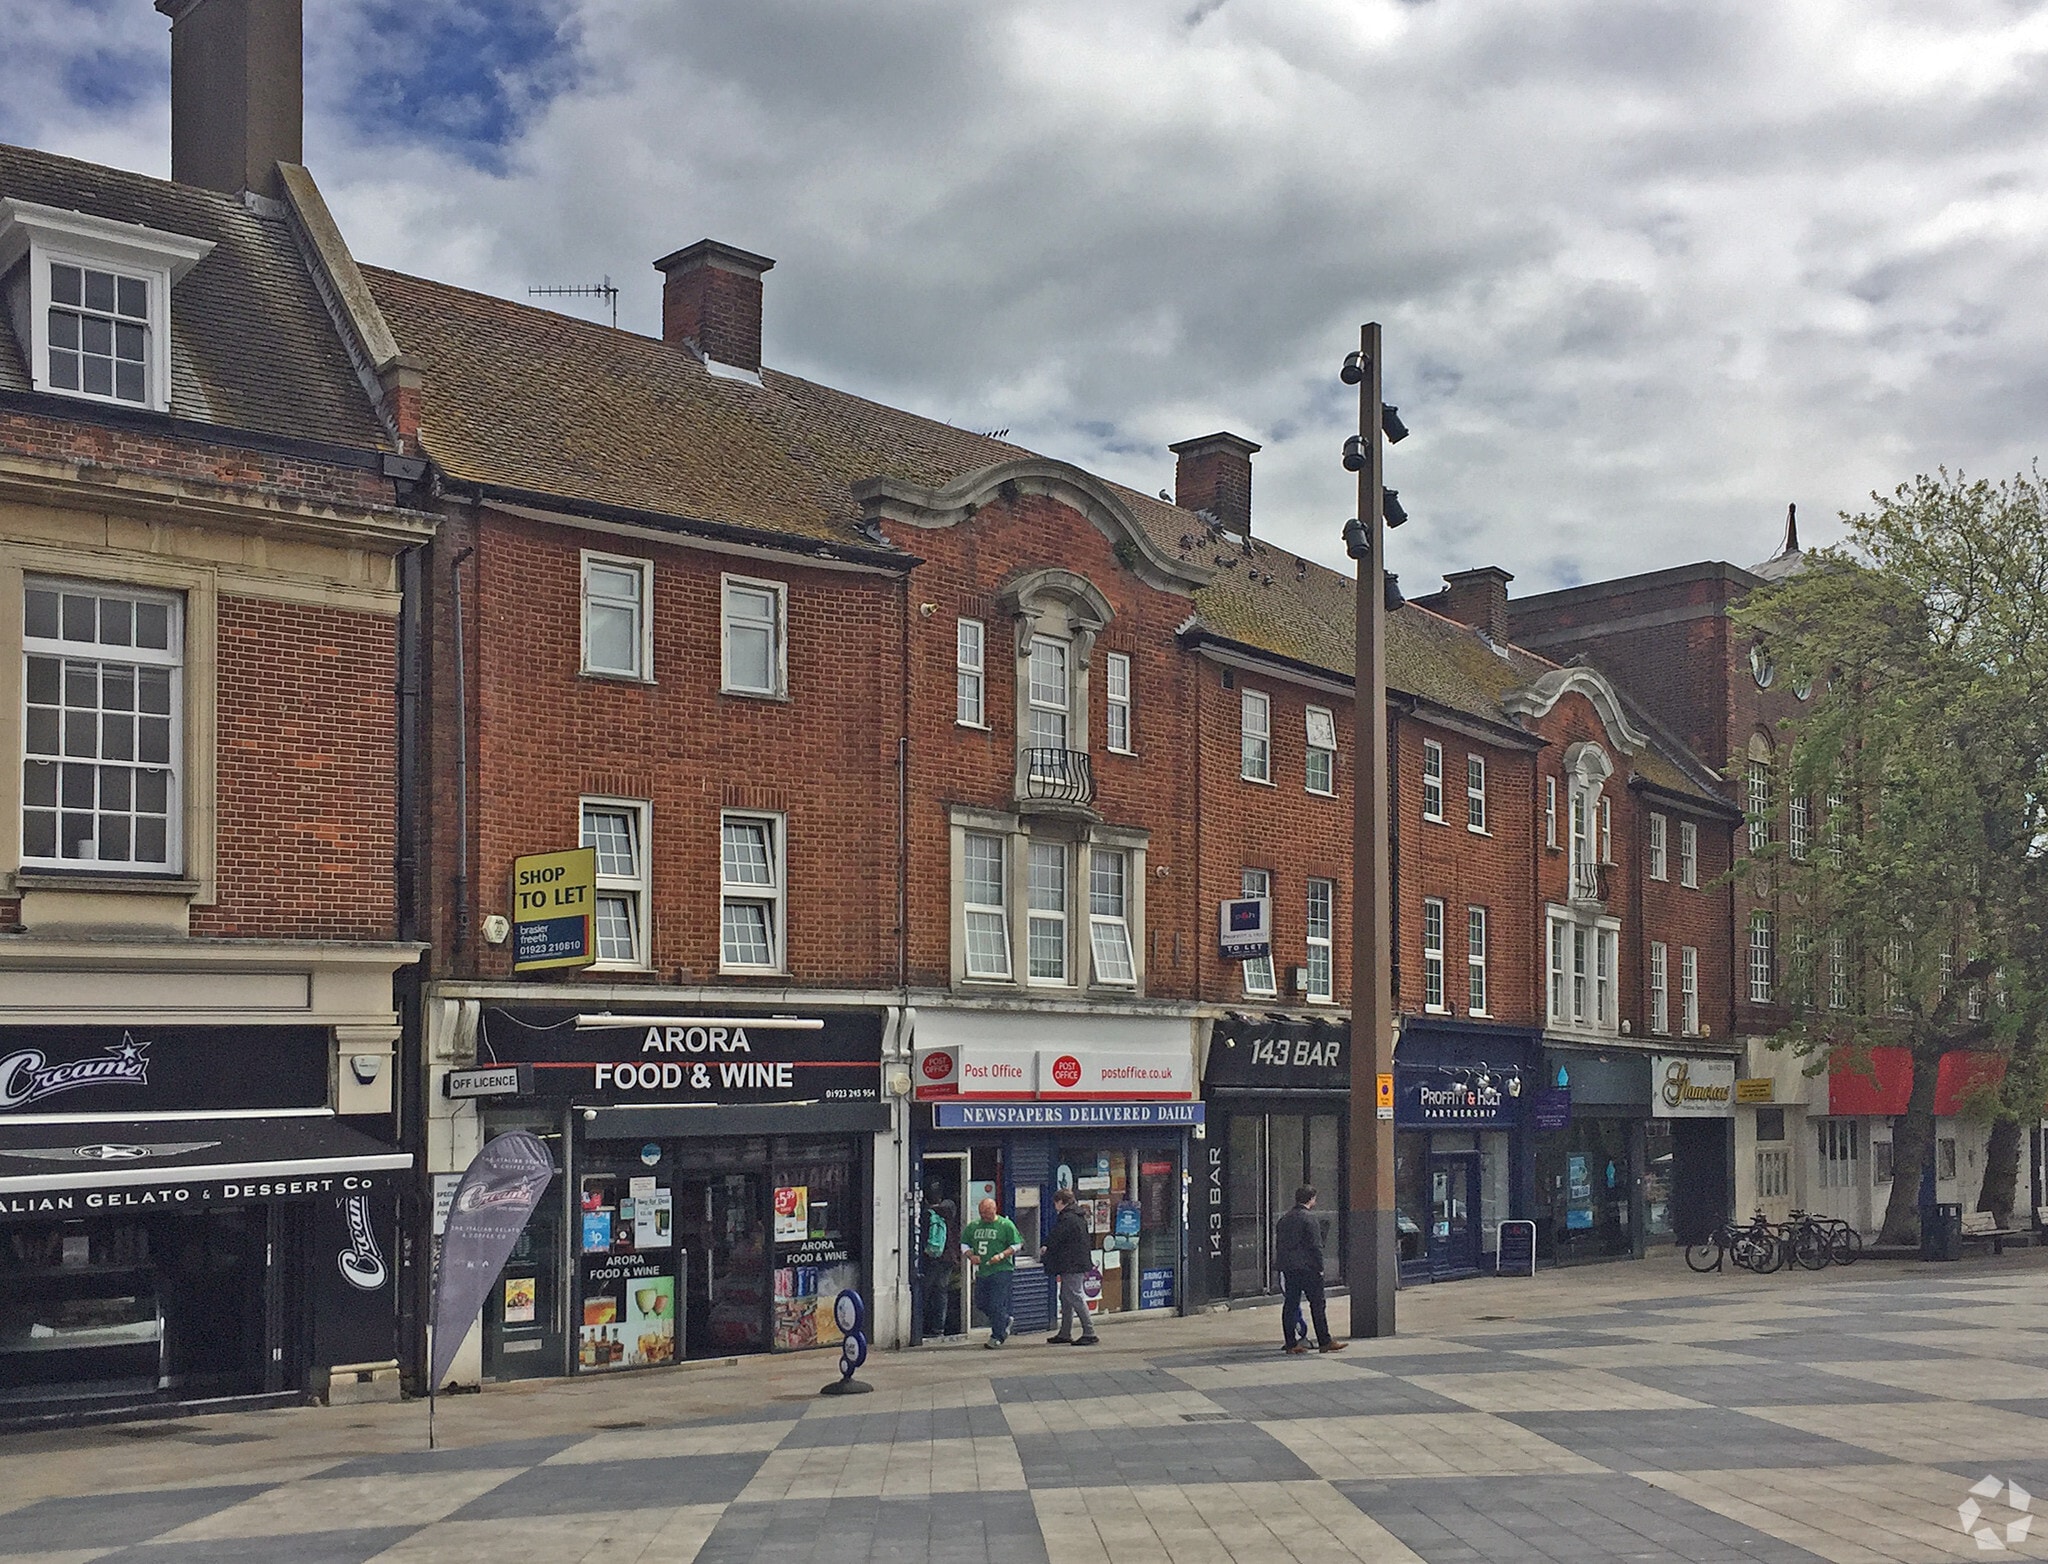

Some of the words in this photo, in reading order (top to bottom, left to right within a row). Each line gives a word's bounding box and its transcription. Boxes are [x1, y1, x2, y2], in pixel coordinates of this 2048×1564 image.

[519, 867, 566, 886] SHOP
[519, 890, 547, 909] TO
[554, 886, 588, 906] LET
[520, 924, 549, 935] brasier
[520, 933, 548, 944] freeth
[520, 943, 547, 955] 01923
[548, 940, 581, 952] 210810
[642, 1027, 751, 1052] ARORA
[1251, 1039, 1290, 1065] 143
[1293, 1040, 1341, 1067] BAR
[928, 1056, 947, 1066] POST
[1058, 1061, 1076, 1071] POST
[595, 1063, 682, 1089] FOOD
[690, 1062, 711, 1089] &
[720, 1062, 794, 1088] WINE
[924, 1064, 950, 1075] OFFICE
[964, 1063, 988, 1078] Post
[991, 1063, 1023, 1078] Office
[1054, 1070, 1079, 1080] OFFICE
[1101, 1066, 1173, 1081] postoffice.co.uk
[453, 1078, 471, 1090] OFF
[474, 1075, 515, 1089] LICENCE
[1467, 1091, 1476, 1106] &
[963, 1107, 1063, 1123] NEWSPAPERS
[1069, 1106, 1151, 1122] DELIVERED
[1157, 1105, 1195, 1121] DAILY
[1425, 1109, 1497, 1118] PARTNERSHIP
[1209, 1147, 1221, 1205] BAR
[86, 1189, 190, 1208] GELATO
[202, 1189, 211, 1200] &
[223, 1179, 333, 1198] DESSERT
[343, 1177, 373, 1190] Co
[973, 1228, 998, 1240] CELTICS
[1209, 1213, 1222, 1259] 143
[801, 1240, 835, 1251] ARORA
[978, 1241, 989, 1255] 5
[606, 1254, 645, 1266] ARORA
[786, 1252, 814, 1264] FOOD
[815, 1252, 822, 1262] &
[824, 1250, 848, 1261] WINE
[590, 1268, 620, 1280] FOOD
[622, 1267, 631, 1278] &
[632, 1265, 661, 1277] WINE
[1151, 1280, 1164, 1289] DRY
[1142, 1288, 1172, 1299] CLEANING
[1149, 1298, 1165, 1307] HERE
